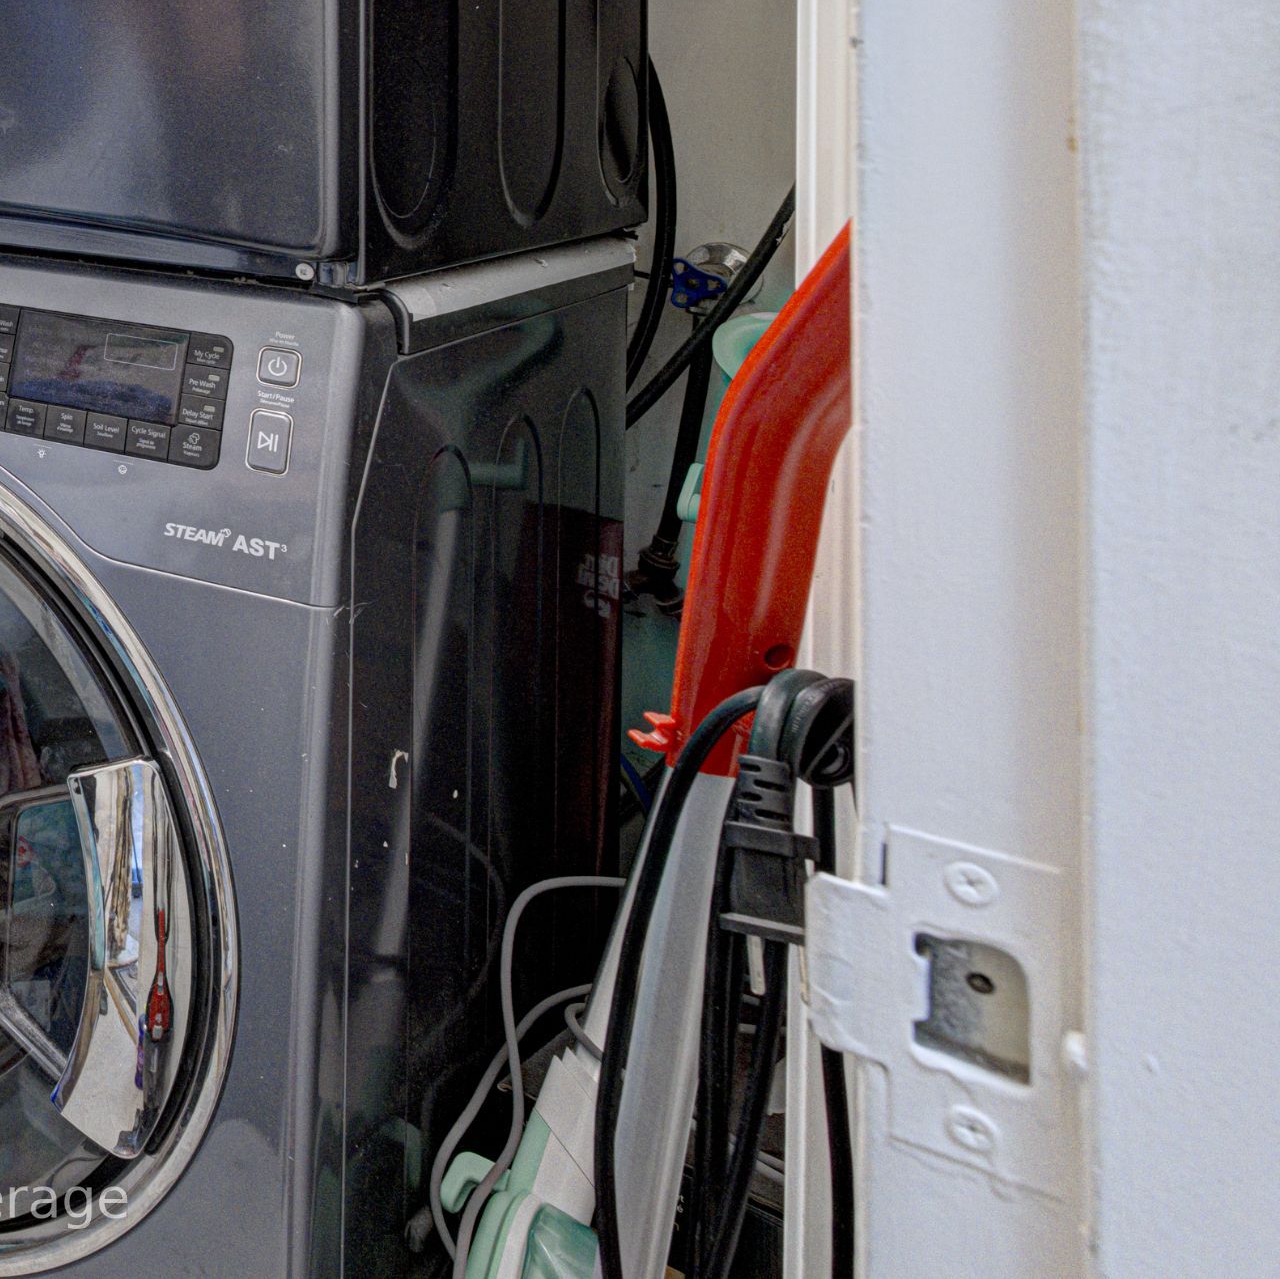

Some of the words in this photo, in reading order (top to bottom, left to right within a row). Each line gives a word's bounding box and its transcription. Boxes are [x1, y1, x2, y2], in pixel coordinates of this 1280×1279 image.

[204, 351, 220, 361] Cycle
[189, 378, 198, 387] Pre
[198, 380, 216, 389] Wash
[258, 390, 295, 403] Start/Pause
[61, 413, 73, 422] Spin
[182, 408, 198, 419] Delay
[198, 411, 214, 420] Start
[93, 422, 104, 431] Soil
[104, 425, 120, 434] Level
[131, 426, 147, 437] Cycle
[148, 428, 166, 440] Signal
[183, 442, 202, 452] Steam
[164, 522, 225, 547] STEAM
